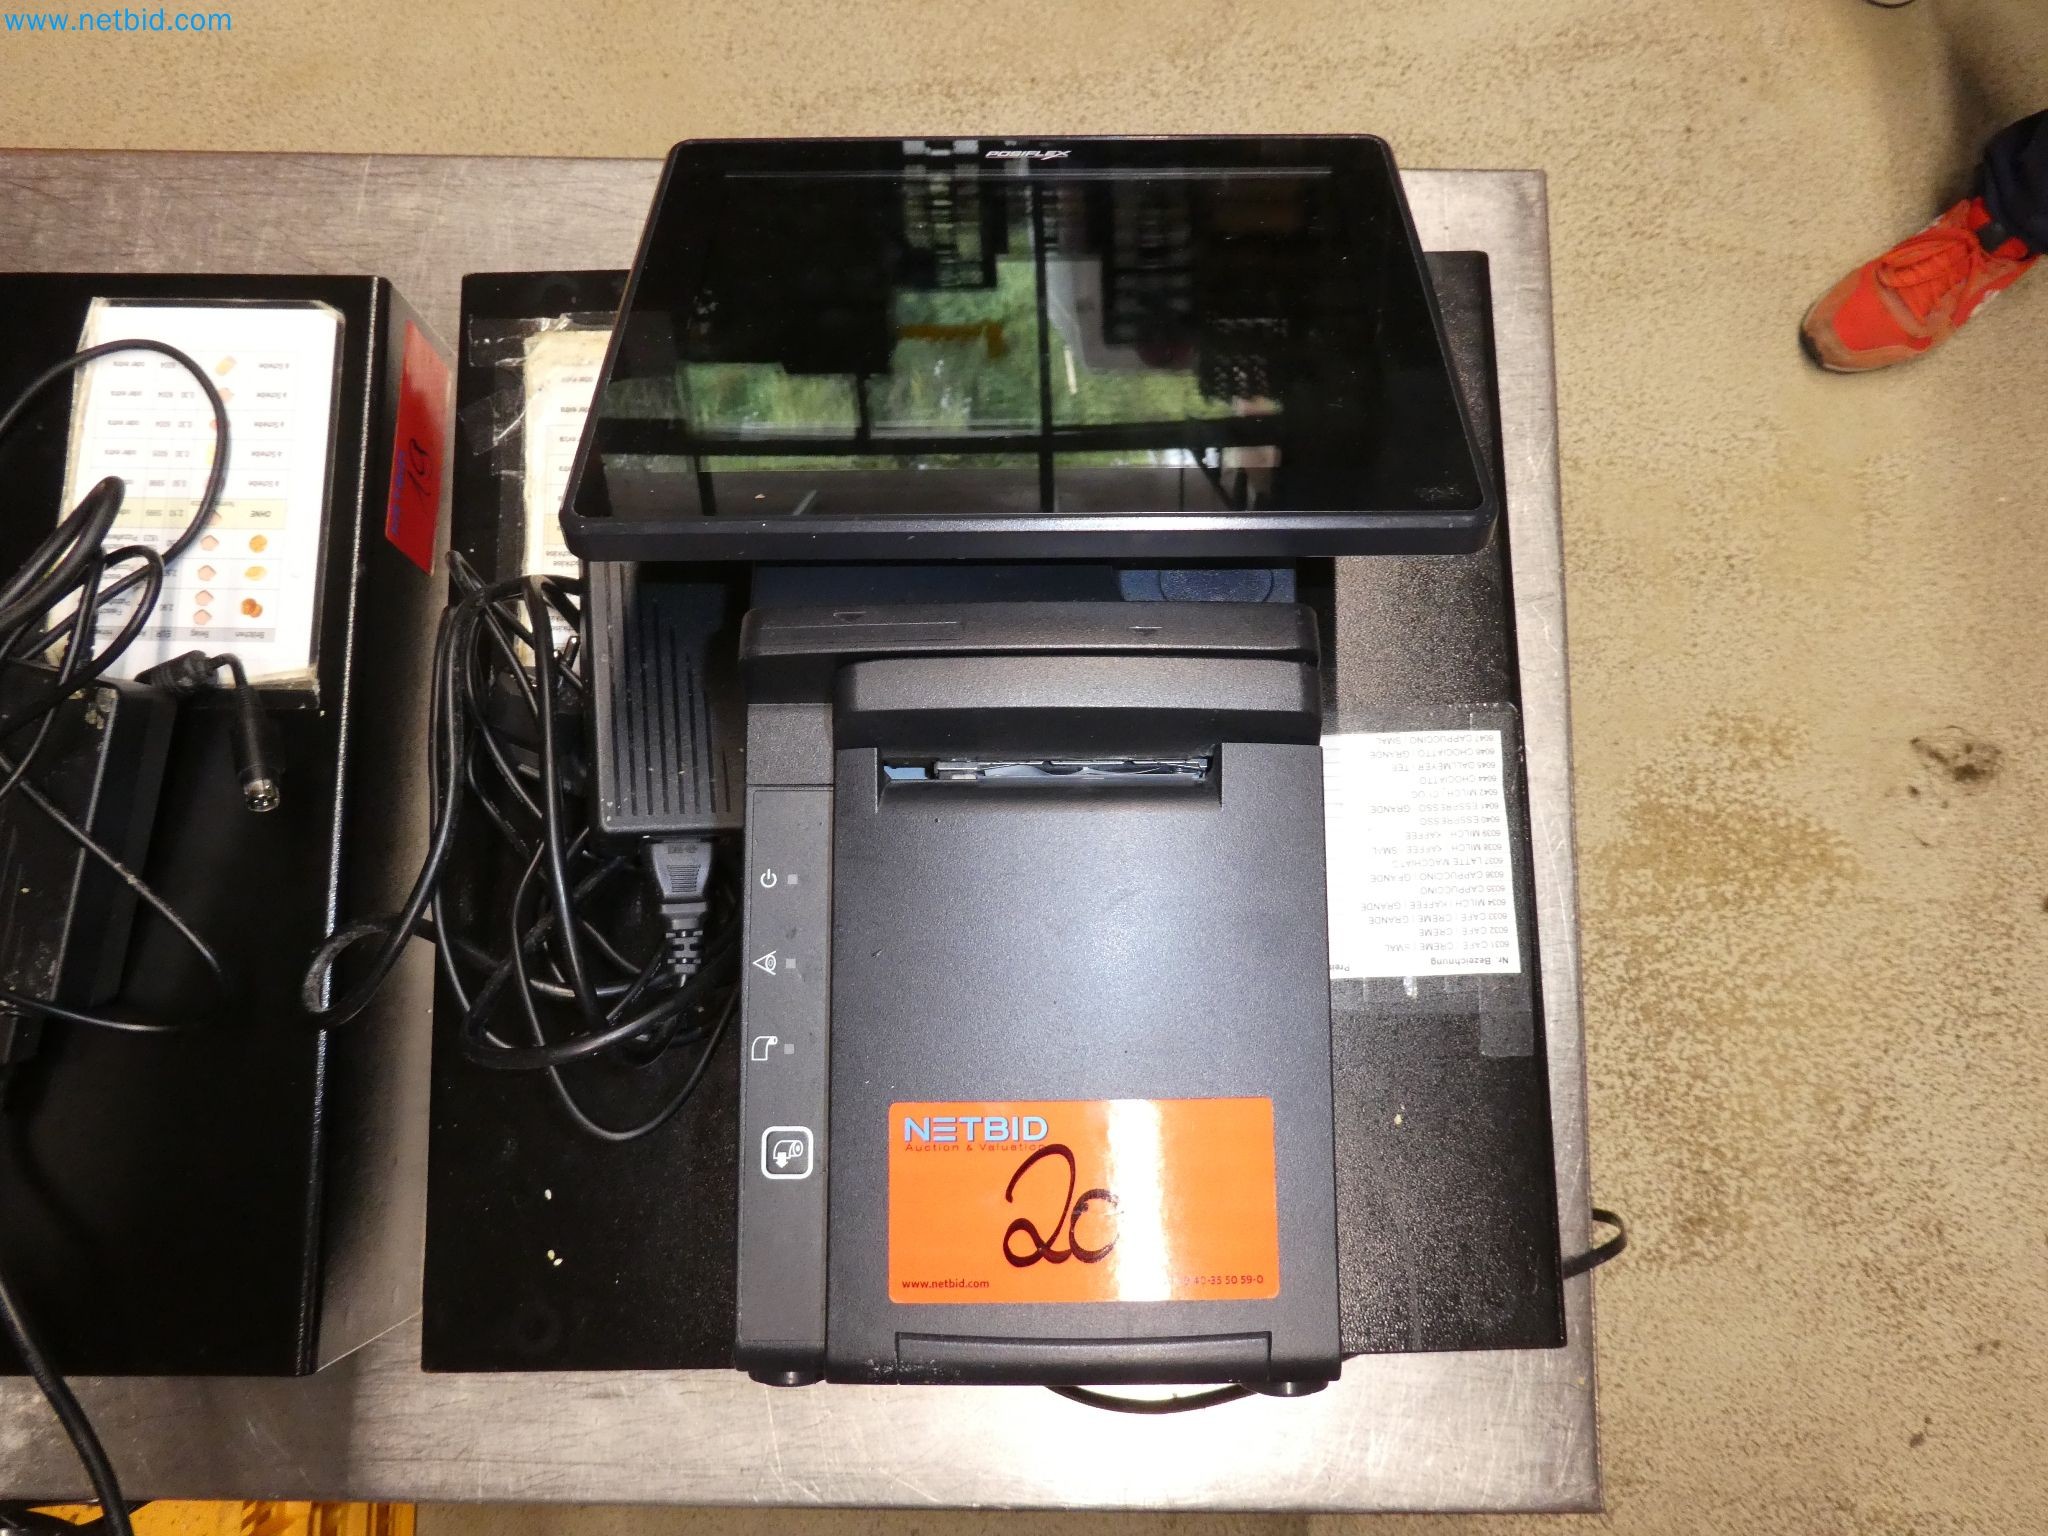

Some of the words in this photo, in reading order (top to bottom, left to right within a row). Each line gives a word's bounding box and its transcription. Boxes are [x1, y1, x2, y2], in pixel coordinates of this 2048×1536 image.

[985, 150, 1072, 160] POSIFLEX
[1369, 805, 1410, 814] GRANDE
[1368, 915, 1408, 924] GRANDE
[1431, 957, 1491, 965] Bezeichnung
[904, 1116, 1048, 1142] NETBID
[905, 1143, 959, 1152] Auction
[966, 1143, 974, 1152] &
[902, 1278, 990, 1288] www.netbid.com
[1225, 1275, 1238, 1285] 50
[1240, 1275, 1264, 1285] 59-0
